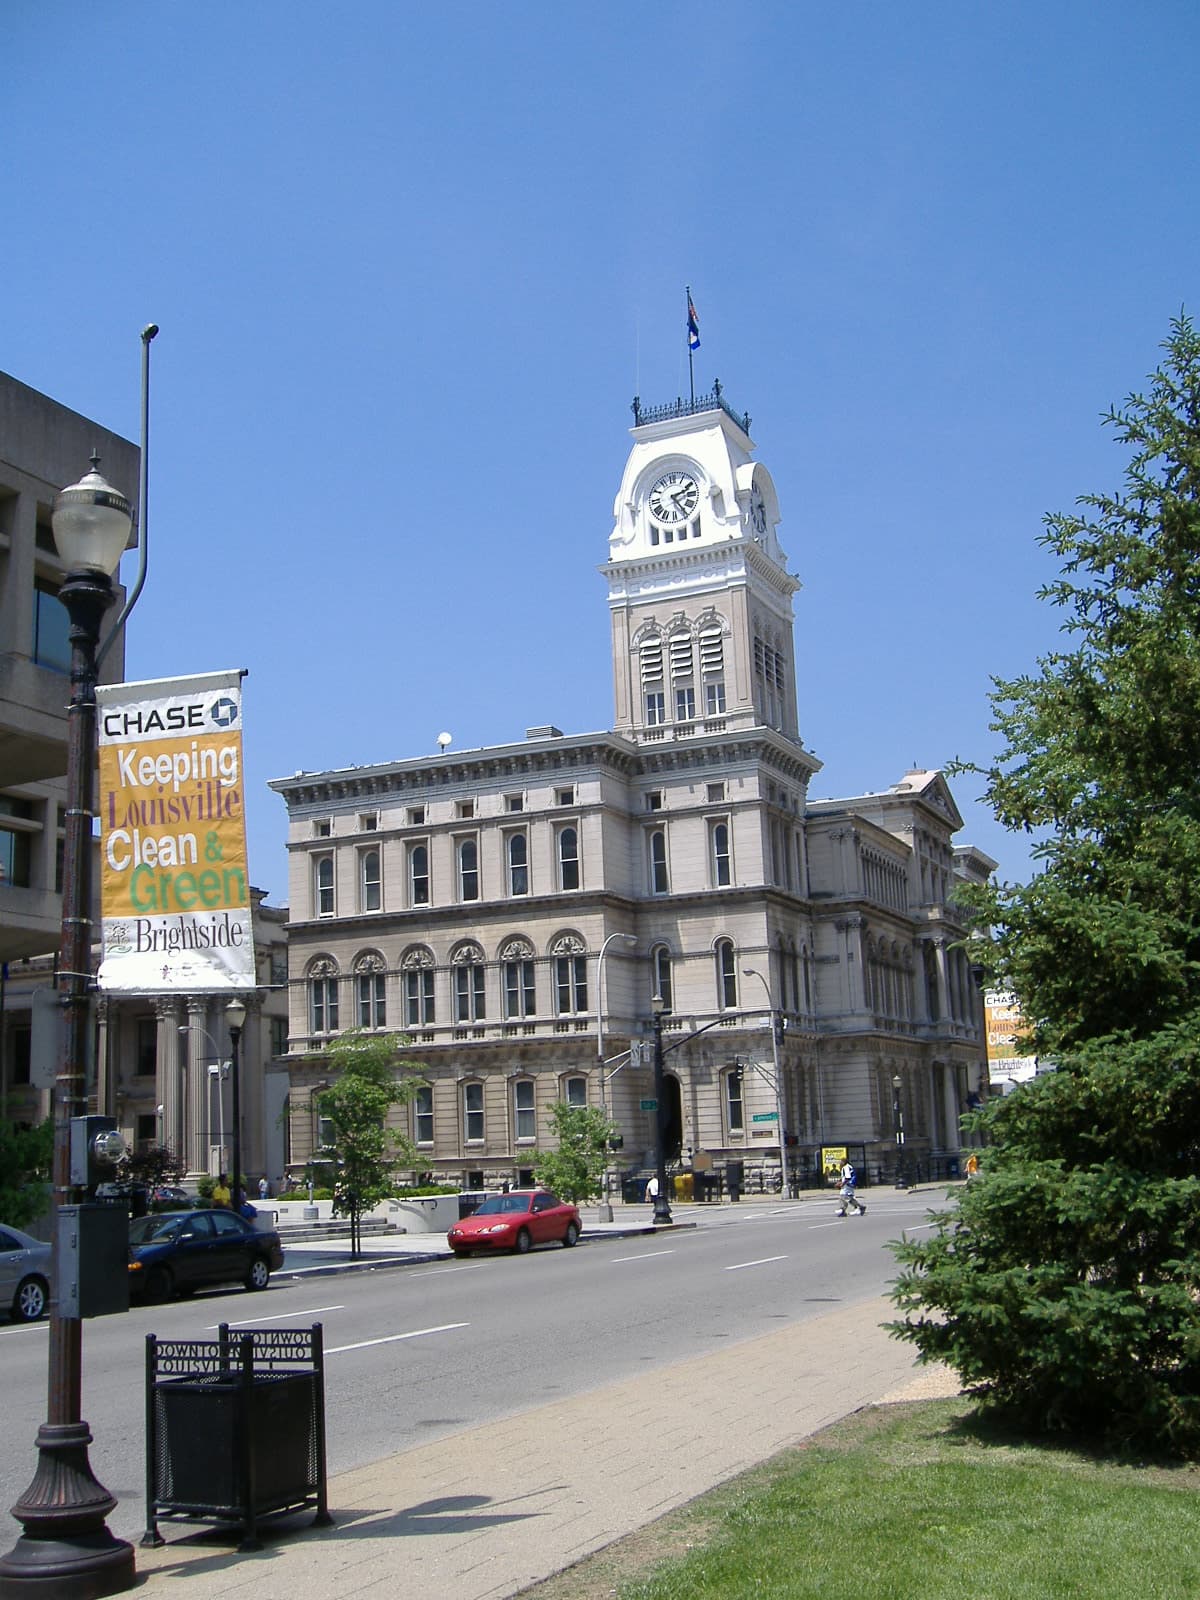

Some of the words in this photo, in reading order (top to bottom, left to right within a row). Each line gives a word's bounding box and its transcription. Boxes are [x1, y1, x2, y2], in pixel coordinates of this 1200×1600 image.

[104, 704, 205, 736] CHASE
[118, 741, 238, 793] Keeping
[108, 780, 240, 829] Louisville
[106, 828, 198, 872] Clean
[204, 831, 224, 862] &
[130, 863, 246, 912] Green
[133, 913, 243, 957] Brightside
[986, 996, 1015, 1005] CHAS
[989, 1032, 1018, 1046] Clea
